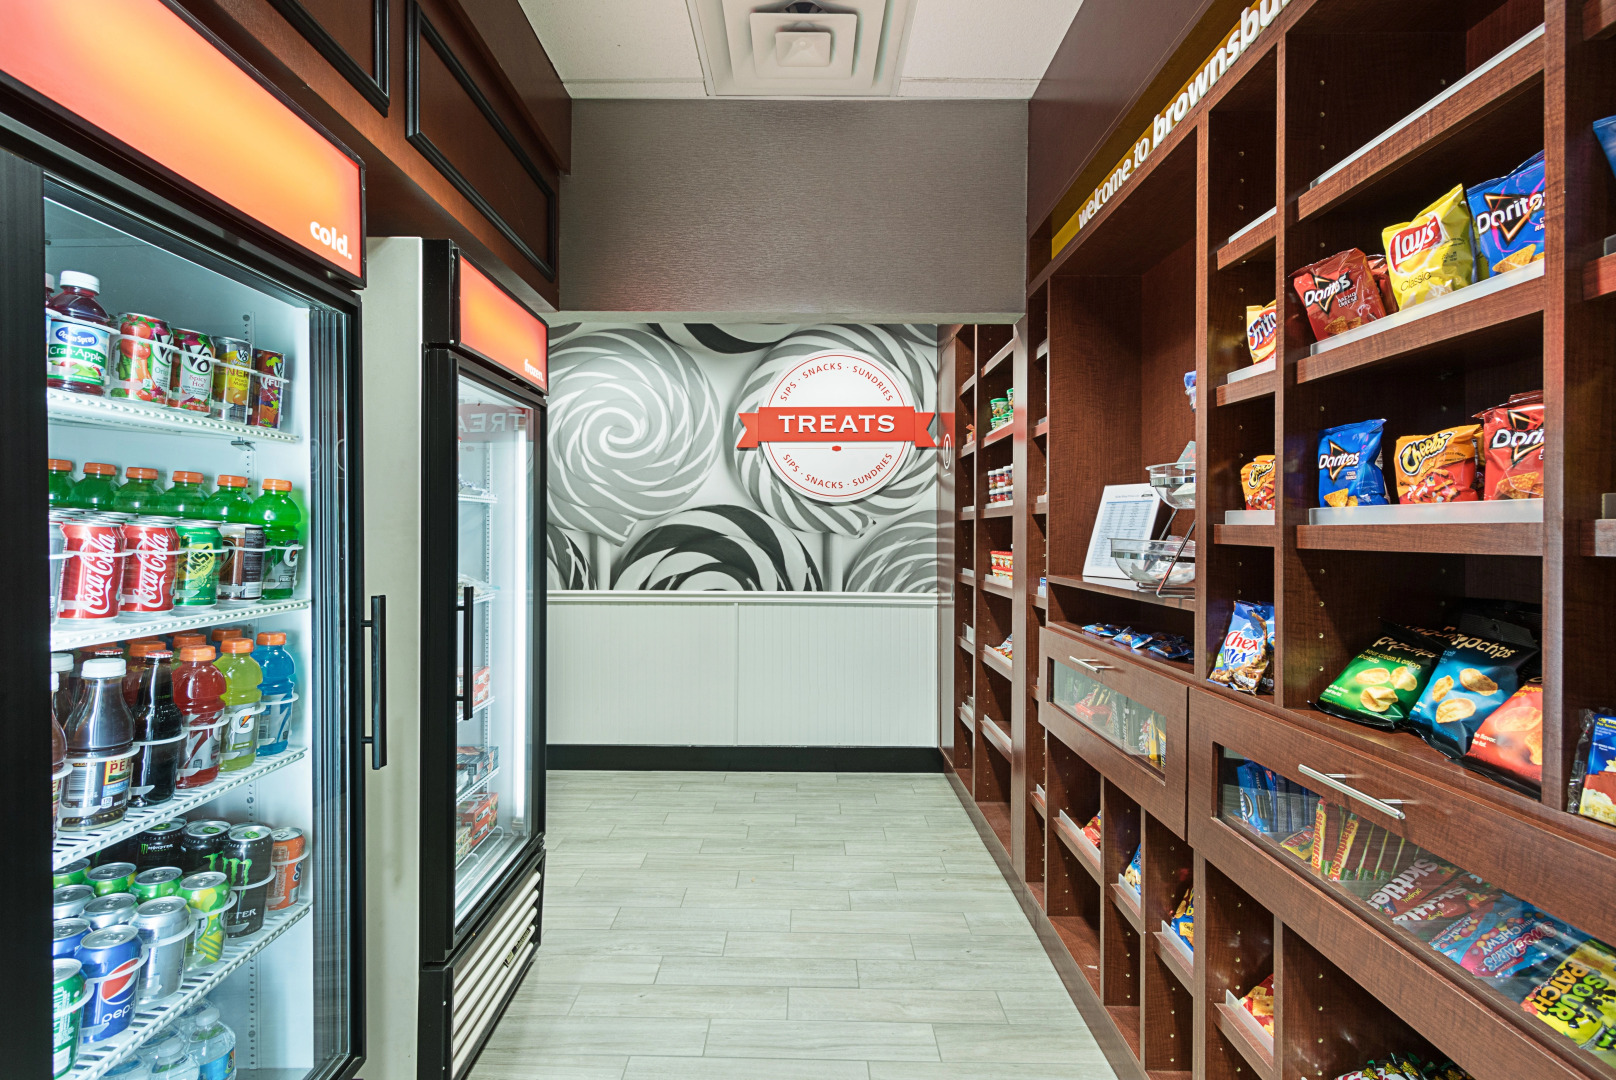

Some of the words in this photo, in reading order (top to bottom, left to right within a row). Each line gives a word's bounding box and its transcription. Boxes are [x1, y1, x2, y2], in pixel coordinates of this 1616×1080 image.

[1078, 158, 1132, 230] welcome
[1133, 137, 1150, 169] to
[1153, 0, 1290, 150] brownsbu
[310, 221, 353, 260] cold.
[1394, 221, 1437, 266] Lay's
[1304, 271, 1352, 308] Doritos
[1400, 271, 1432, 292] Classic
[49, 345, 104, 363] Cran-Apple
[524, 358, 544, 382] frozen.
[780, 381, 798, 402] SIPS
[802, 362, 843, 379] SNACKS
[852, 365, 894, 402] SUNDRIES
[778, 414, 896, 433] TREATS
[1492, 428, 1545, 448] Dori
[783, 453, 800, 473] SIPS
[804, 473, 844, 490] SNACKS
[852, 452, 893, 488] SUNDRIES
[1318, 451, 1360, 469] Doritos
[1224, 648, 1255, 664] Mix
[1225, 631, 1260, 651] Chex
[1311, 811, 1324, 871] Starburst
[1331, 821, 1356, 877] Starburst
[1481, 925, 1522, 956] CHEWY
[1533, 960, 1591, 1015] PATCH
[1548, 974, 1609, 1021] SOUR
